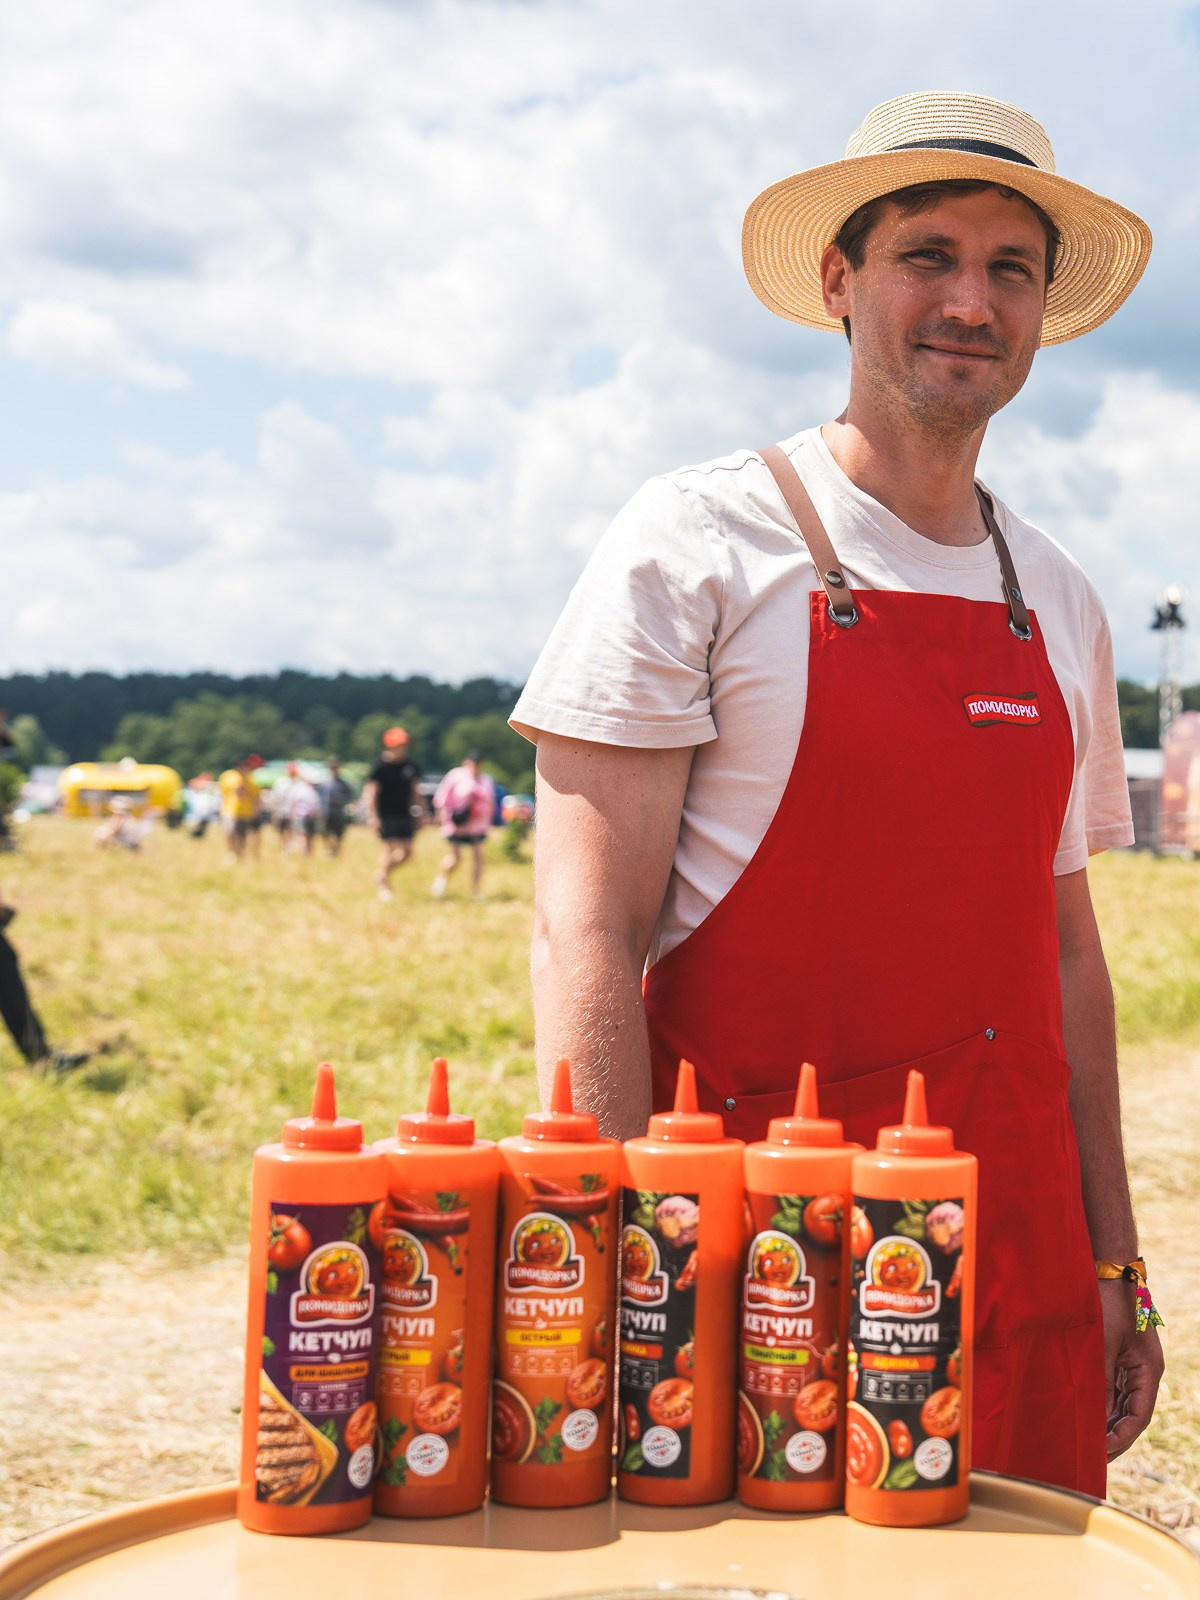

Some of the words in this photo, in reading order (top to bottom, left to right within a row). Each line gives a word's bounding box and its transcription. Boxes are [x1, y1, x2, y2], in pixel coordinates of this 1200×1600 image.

[968, 701, 1039, 718] ПОМИДОРКА
[383, 1285, 430, 1303] ИДОРКА
[623, 1280, 661, 1297] ИДОРКА
[504, 1296, 584, 1318] КЕТЧУП
[381, 1315, 435, 1337] ТЧУП
[621, 1308, 667, 1333] ЕТЧУП
[744, 1311, 813, 1338] КЕТЧУП
[860, 1319, 939, 1343] КЕТЧУП
[289, 1327, 372, 1352] КЕТЧУП
